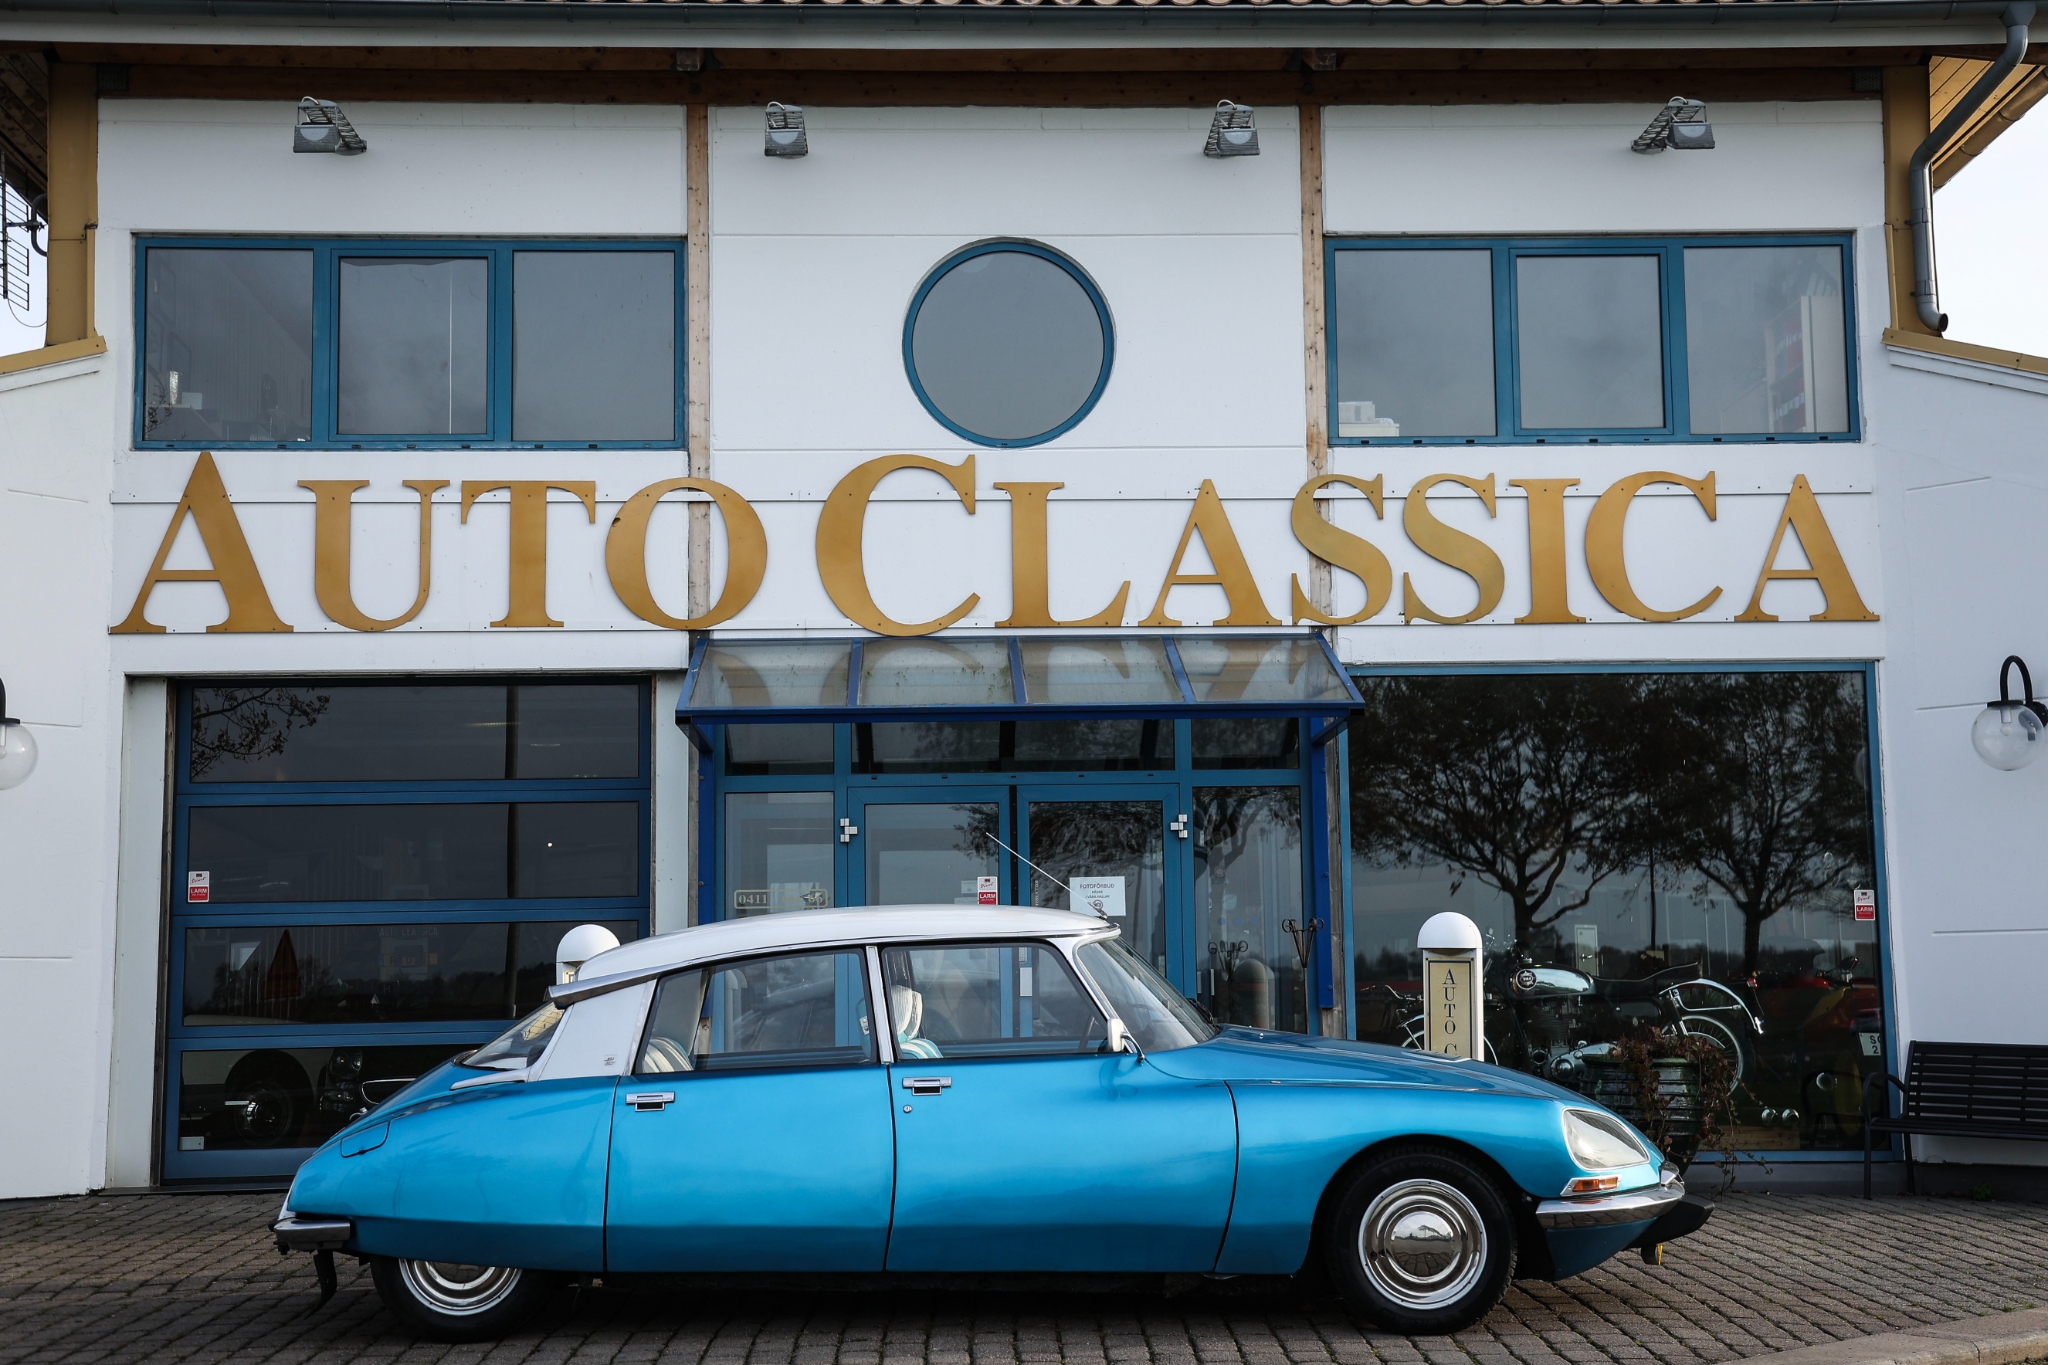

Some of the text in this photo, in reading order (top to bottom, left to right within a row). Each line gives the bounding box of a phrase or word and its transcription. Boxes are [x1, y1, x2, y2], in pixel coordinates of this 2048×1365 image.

[109, 451, 1880, 637] AUTO CLASSICA
[738, 894, 768, 905] 0411
[1442, 968, 1457, 1035] AUTO
